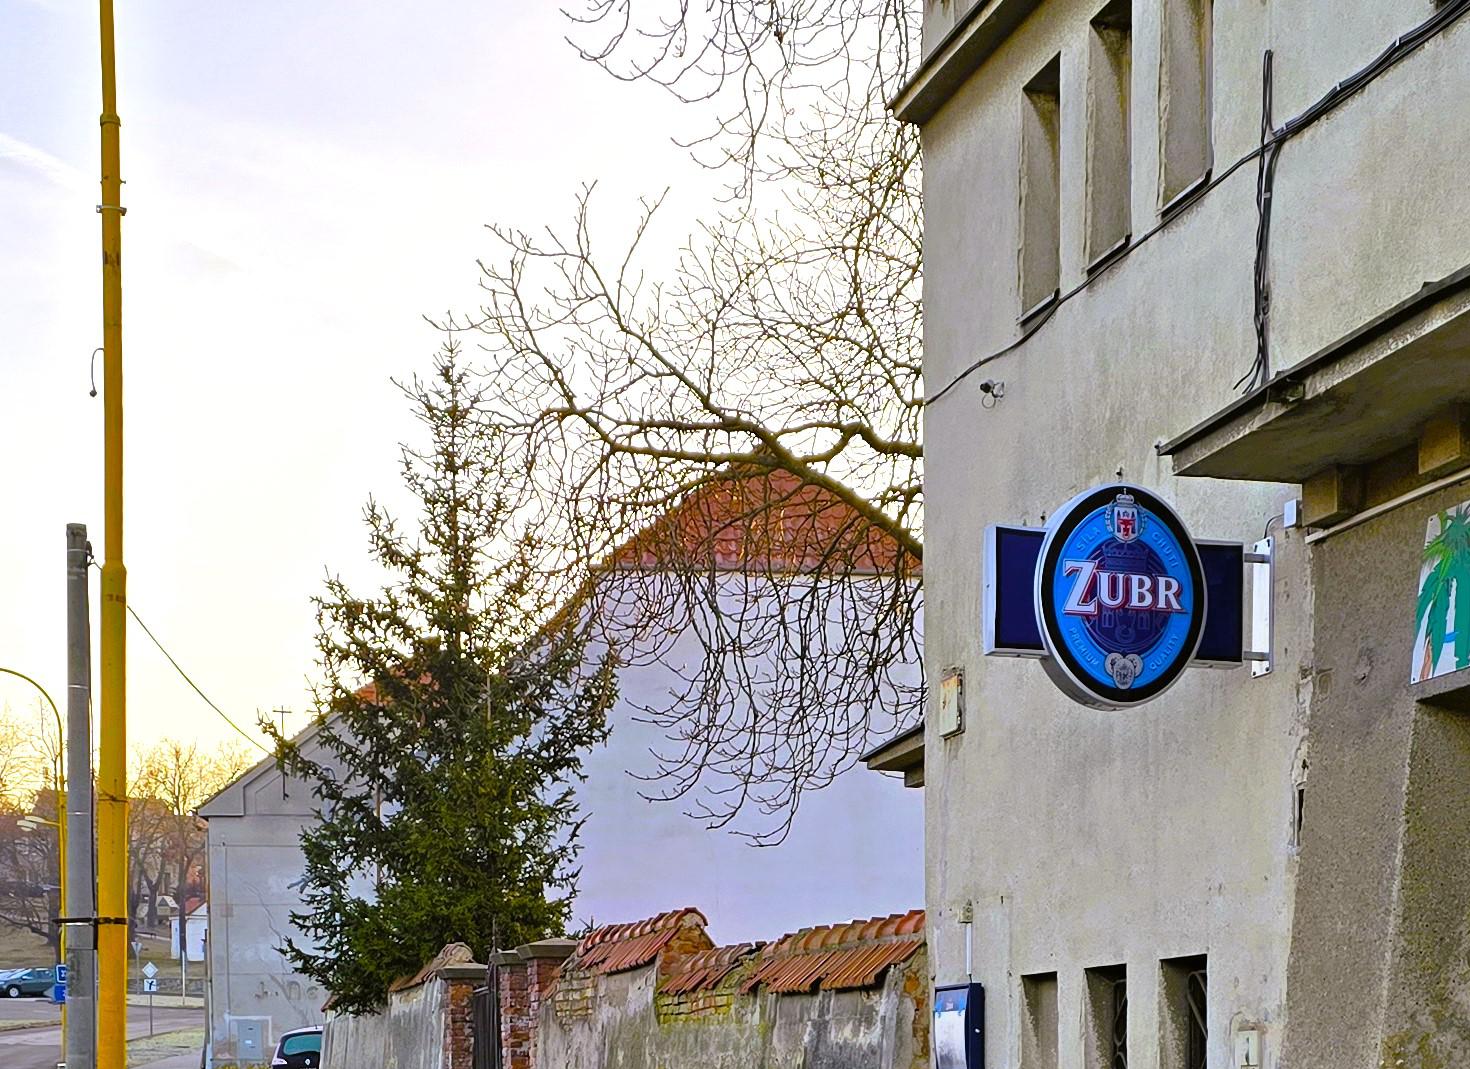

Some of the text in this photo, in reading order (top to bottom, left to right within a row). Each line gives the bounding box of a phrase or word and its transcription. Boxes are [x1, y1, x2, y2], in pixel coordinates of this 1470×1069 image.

[1061, 557, 1186, 616] ZUBR
[1068, 626, 1179, 670] PREMIUM QUALITY
